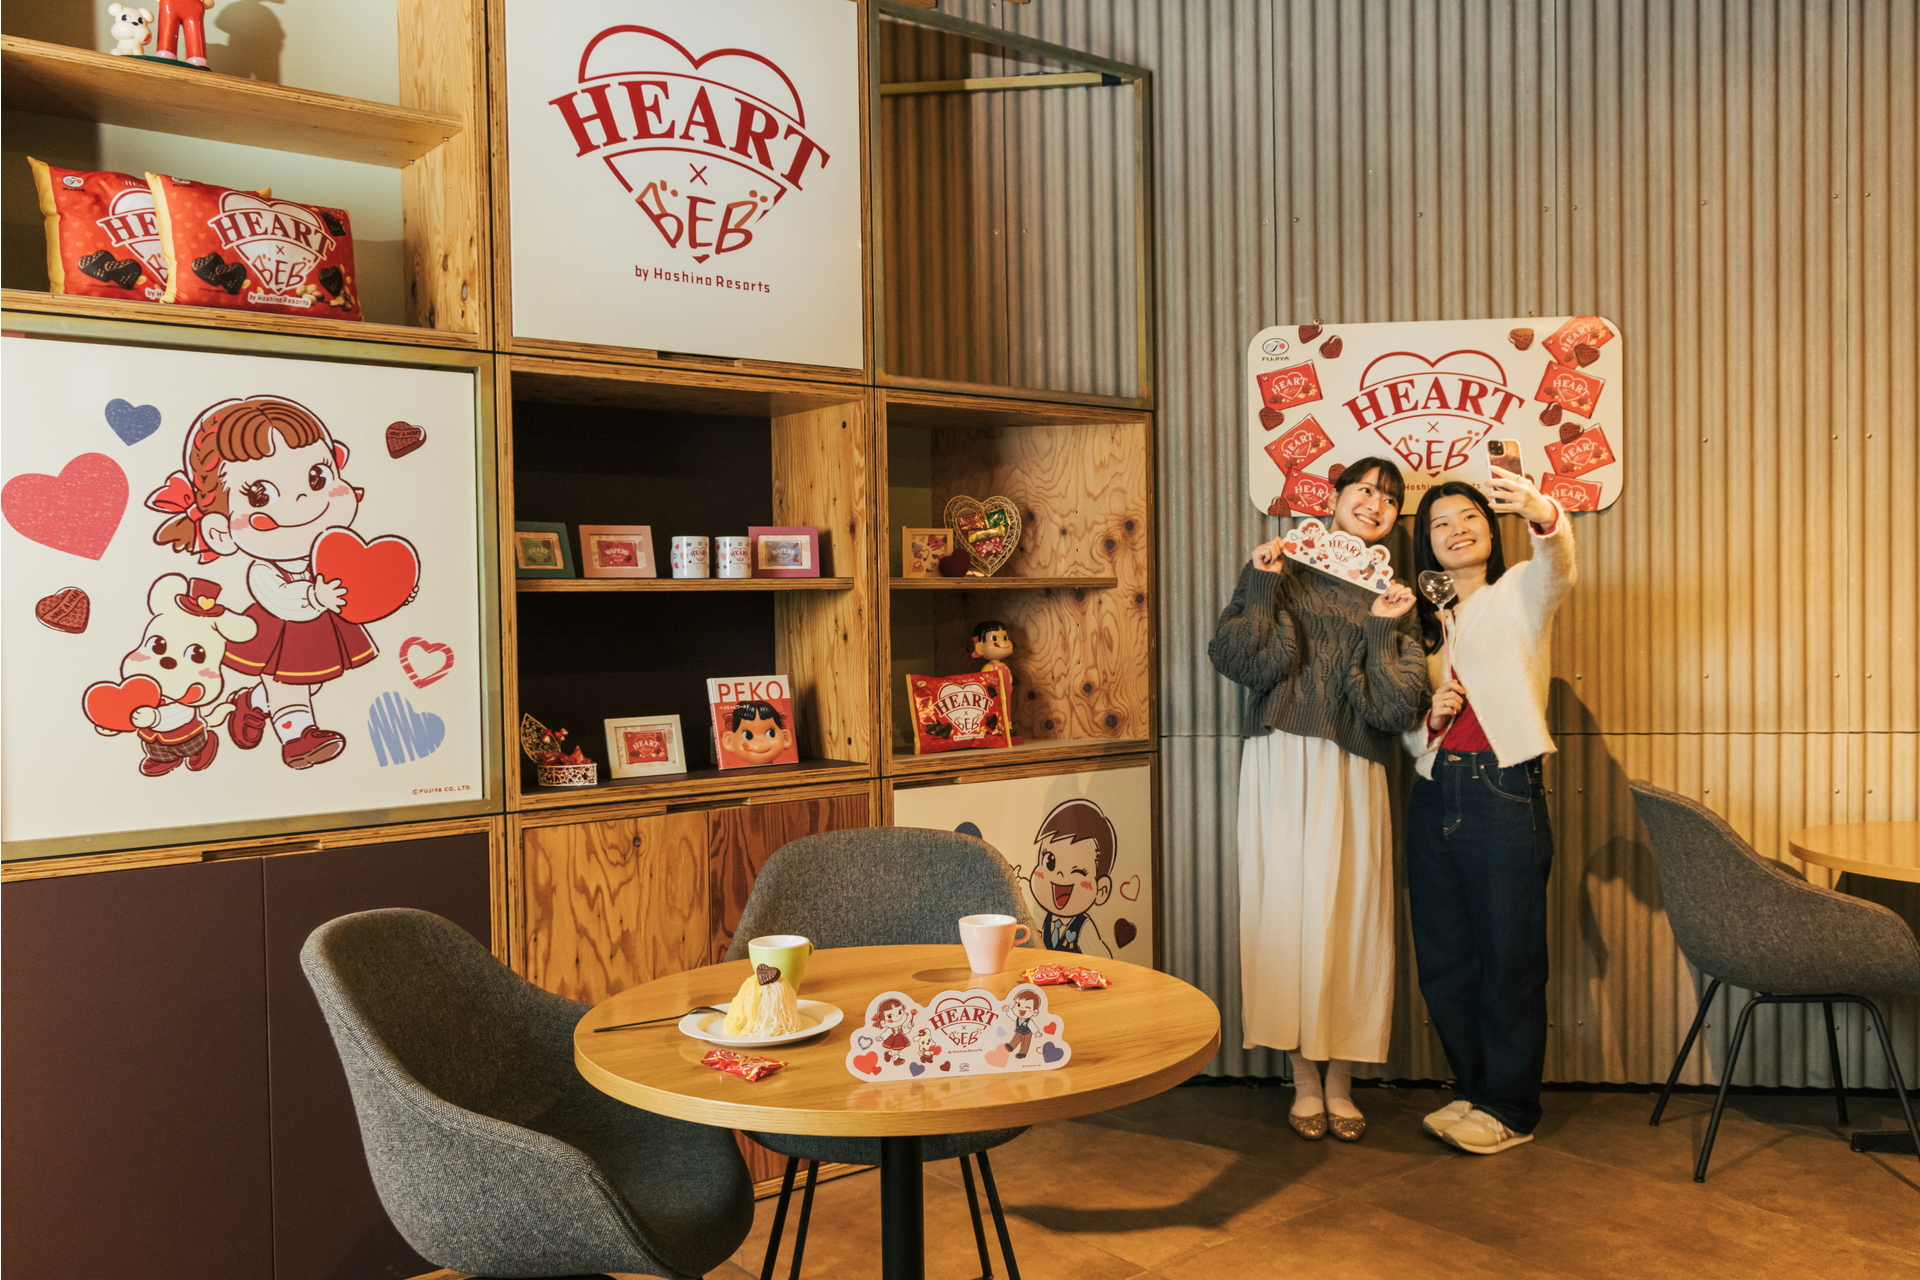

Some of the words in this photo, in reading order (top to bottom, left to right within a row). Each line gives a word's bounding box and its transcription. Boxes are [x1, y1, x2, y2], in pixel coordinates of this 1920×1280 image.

[547, 80, 831, 192] HEART
[211, 211, 334, 260] HEART
[635, 264, 649, 282] by
[654, 266, 712, 286] Hoshino
[716, 275, 770, 294] Resorts
[1561, 324, 1592, 352] HEART
[1271, 377, 1308, 395] HEART
[1553, 379, 1591, 398] HEART
[1342, 376, 1526, 432] HEART
[1283, 432, 1314, 459] HEART
[1561, 441, 1598, 463] HEART
[1295, 485, 1330, 500] HEART
[1551, 488, 1590, 503] HEART
[1328, 540, 1363, 558] HEART
[717, 680, 784, 702] PEKO
[934, 692, 993, 715] HEART
[632, 739, 660, 750] HEART
[928, 1007, 999, 1031] HEART
